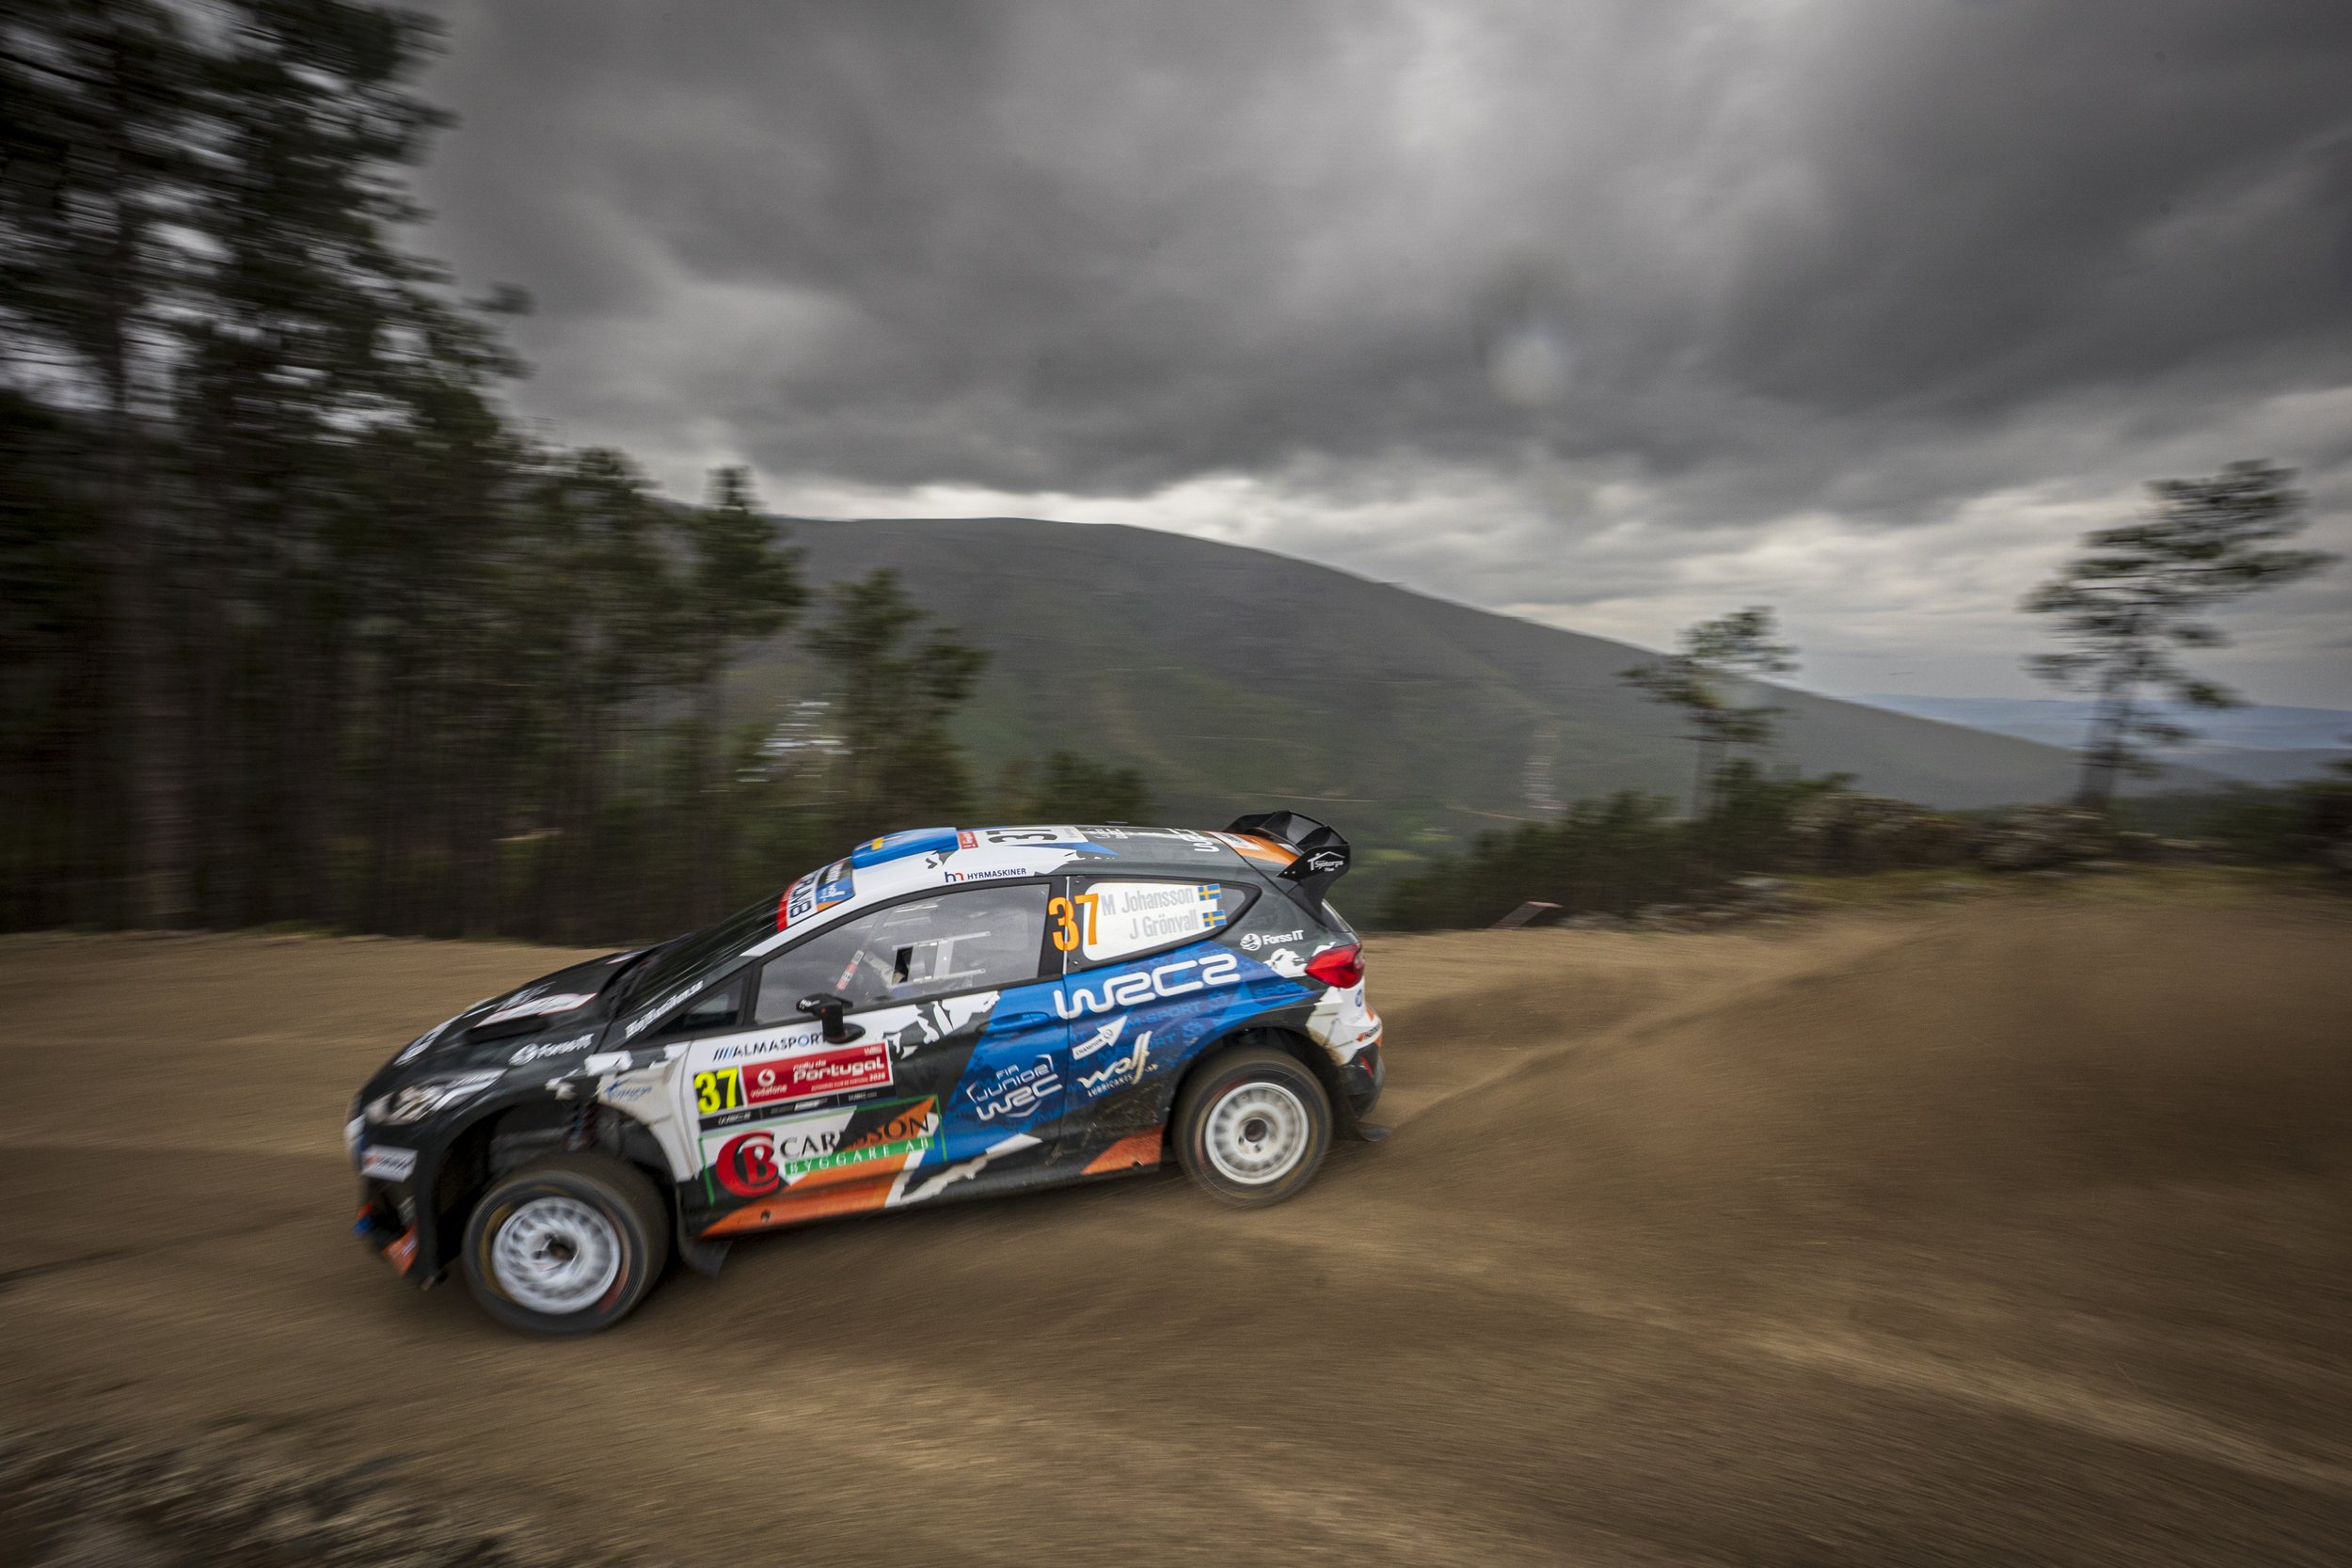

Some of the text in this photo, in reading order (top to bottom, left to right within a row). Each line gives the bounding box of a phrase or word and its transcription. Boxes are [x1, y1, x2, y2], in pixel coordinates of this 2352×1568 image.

[966, 866, 1027, 881] HYRMASKINER
[1101, 886, 1195, 917] M Johansson
[1048, 893, 1100, 952] 37
[1129, 909, 1200, 940] J Grönvall
[1053, 953, 1242, 1021] WRC2
[793, 1055, 885, 1085] Portugal
[977, 1063, 1051, 1101] JUNIOR
[995, 1064, 1020, 1081] FIA
[693, 1068, 739, 1115] 37
[750, 1084, 788, 1099] vodafone
[976, 1072, 1063, 1122] WRC
[789, 1136, 929, 1175] BYGGARE AB
